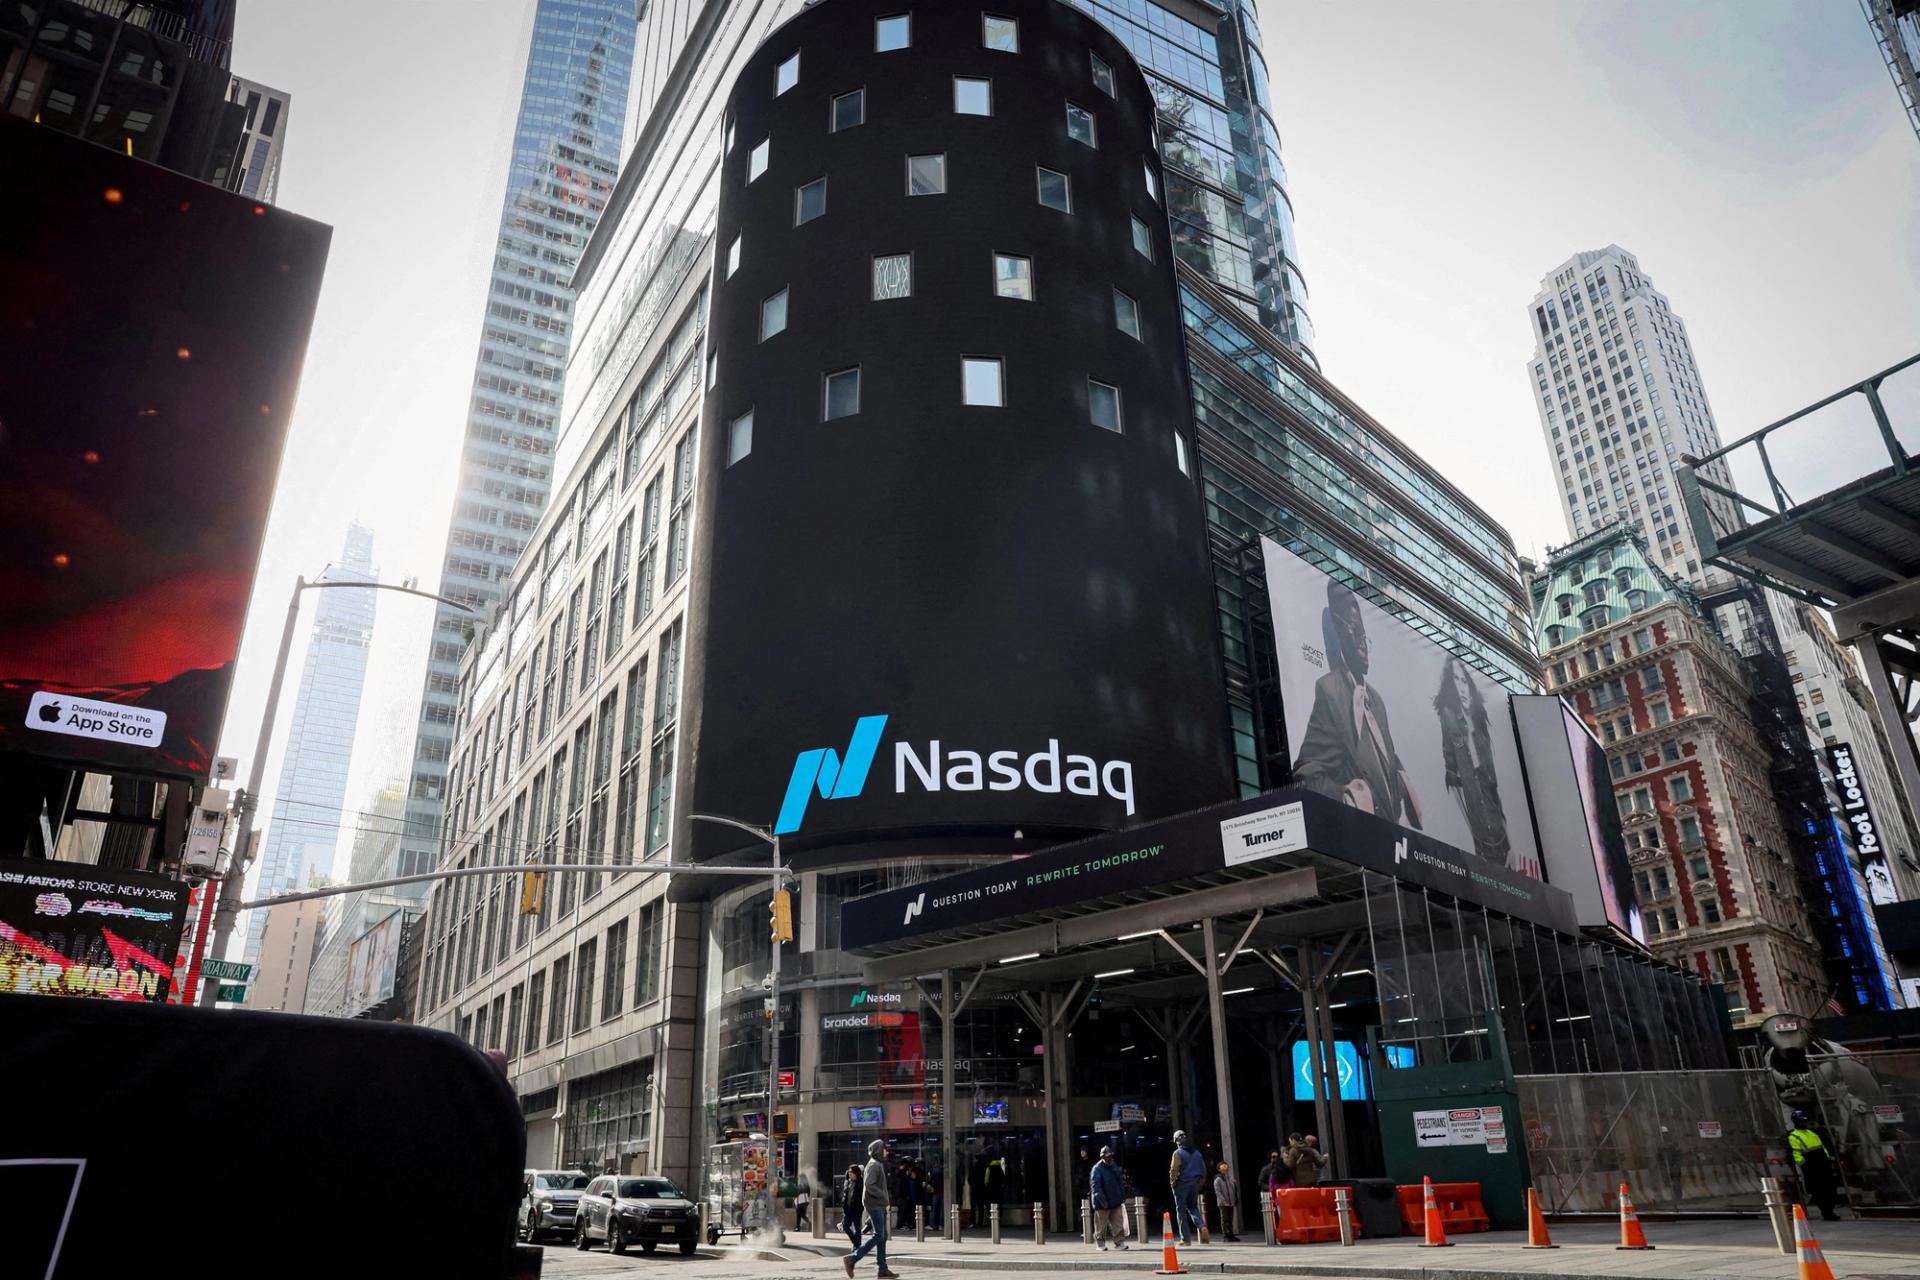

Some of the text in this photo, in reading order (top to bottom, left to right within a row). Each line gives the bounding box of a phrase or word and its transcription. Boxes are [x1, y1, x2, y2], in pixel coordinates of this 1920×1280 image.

[72, 704, 151, 723] Download on the
[66, 714, 153, 739] App Store
[895, 738, 1136, 816] Nasdaq
[1234, 819, 1256, 828] Broadway
[1242, 829, 1285, 847] Turner
[1851, 812, 1880, 854] Foot
[1413, 850, 1446, 870] QUESTION
[1447, 862, 1467, 878] TODAY
[1470, 871, 1498, 889] REWRITE
[78, 881, 114, 894] STORE
[118, 886, 144, 898] NEW
[146, 888, 177, 901] YORK
[932, 888, 981, 908] QUESTION
[985, 880, 1018, 896] TODAY
[1026, 865, 1080, 886] REWRITE
[222, 987, 235, 1000] 43
[867, 993, 901, 1004] Nasdaq
[920, 1059, 971, 1072] Nasaq
[1416, 1117, 1447, 1129] PEDESTRIANS
[1452, 1110, 1477, 1119] DANGER
